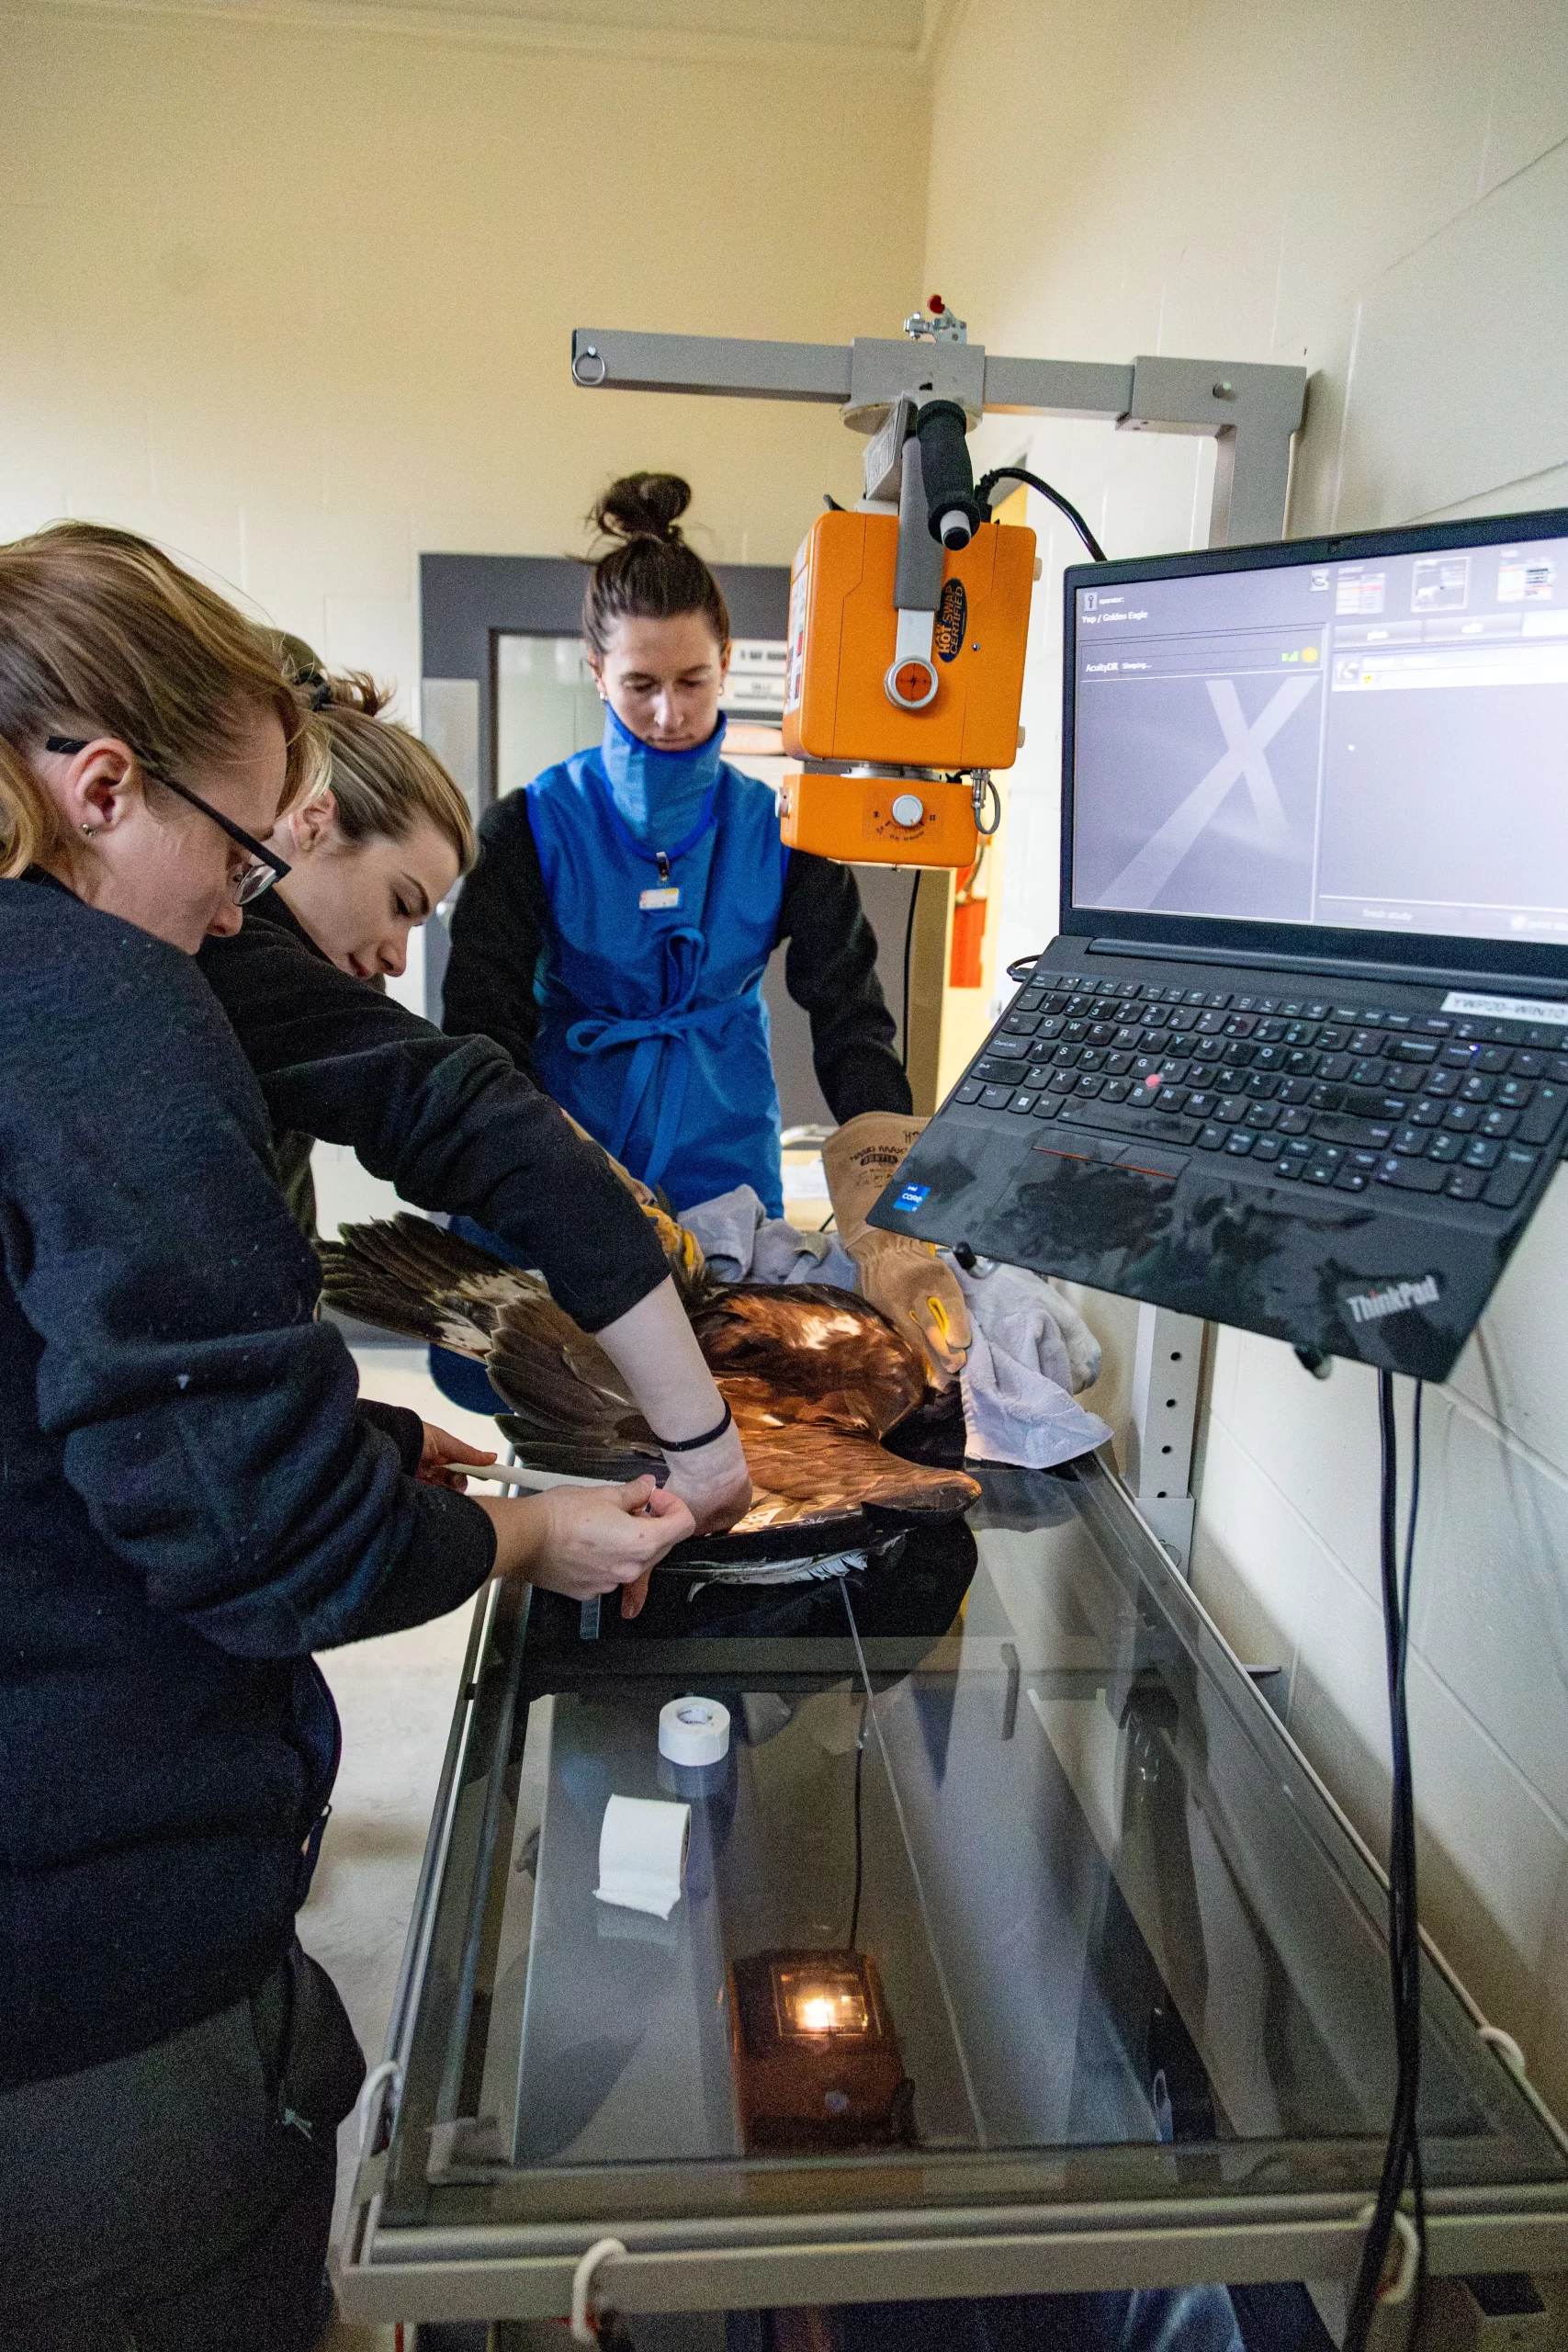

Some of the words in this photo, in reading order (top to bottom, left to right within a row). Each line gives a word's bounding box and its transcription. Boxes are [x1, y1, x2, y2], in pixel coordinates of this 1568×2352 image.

[942, 585, 954, 623] SWAP
[1103, 613, 1127, 621] Golden
[1128, 611, 1148, 620] Eagle
[950, 586, 964, 654] CERTIFIED
[938, 625, 952, 653] HOT
[1086, 662, 1119, 673] AcuityDR
[1119, 1029, 1129, 1037] R
[1175, 1036, 1185, 1045] Y
[1201, 1040, 1213, 1048] U
[1110, 1054, 1120, 1062] F
[1137, 1058, 1147, 1067] G
[1165, 1062, 1176, 1070] H
[1193, 1067, 1203, 1075] J
[1222, 1071, 1234, 1080] K
[1056, 1073, 1066, 1081] X
[1134, 1088, 1144, 1097] B
[1162, 1090, 1175, 1099] N
[1191, 1095, 1204, 1103] M
[1346, 1274, 1439, 1323] ThinkPad
